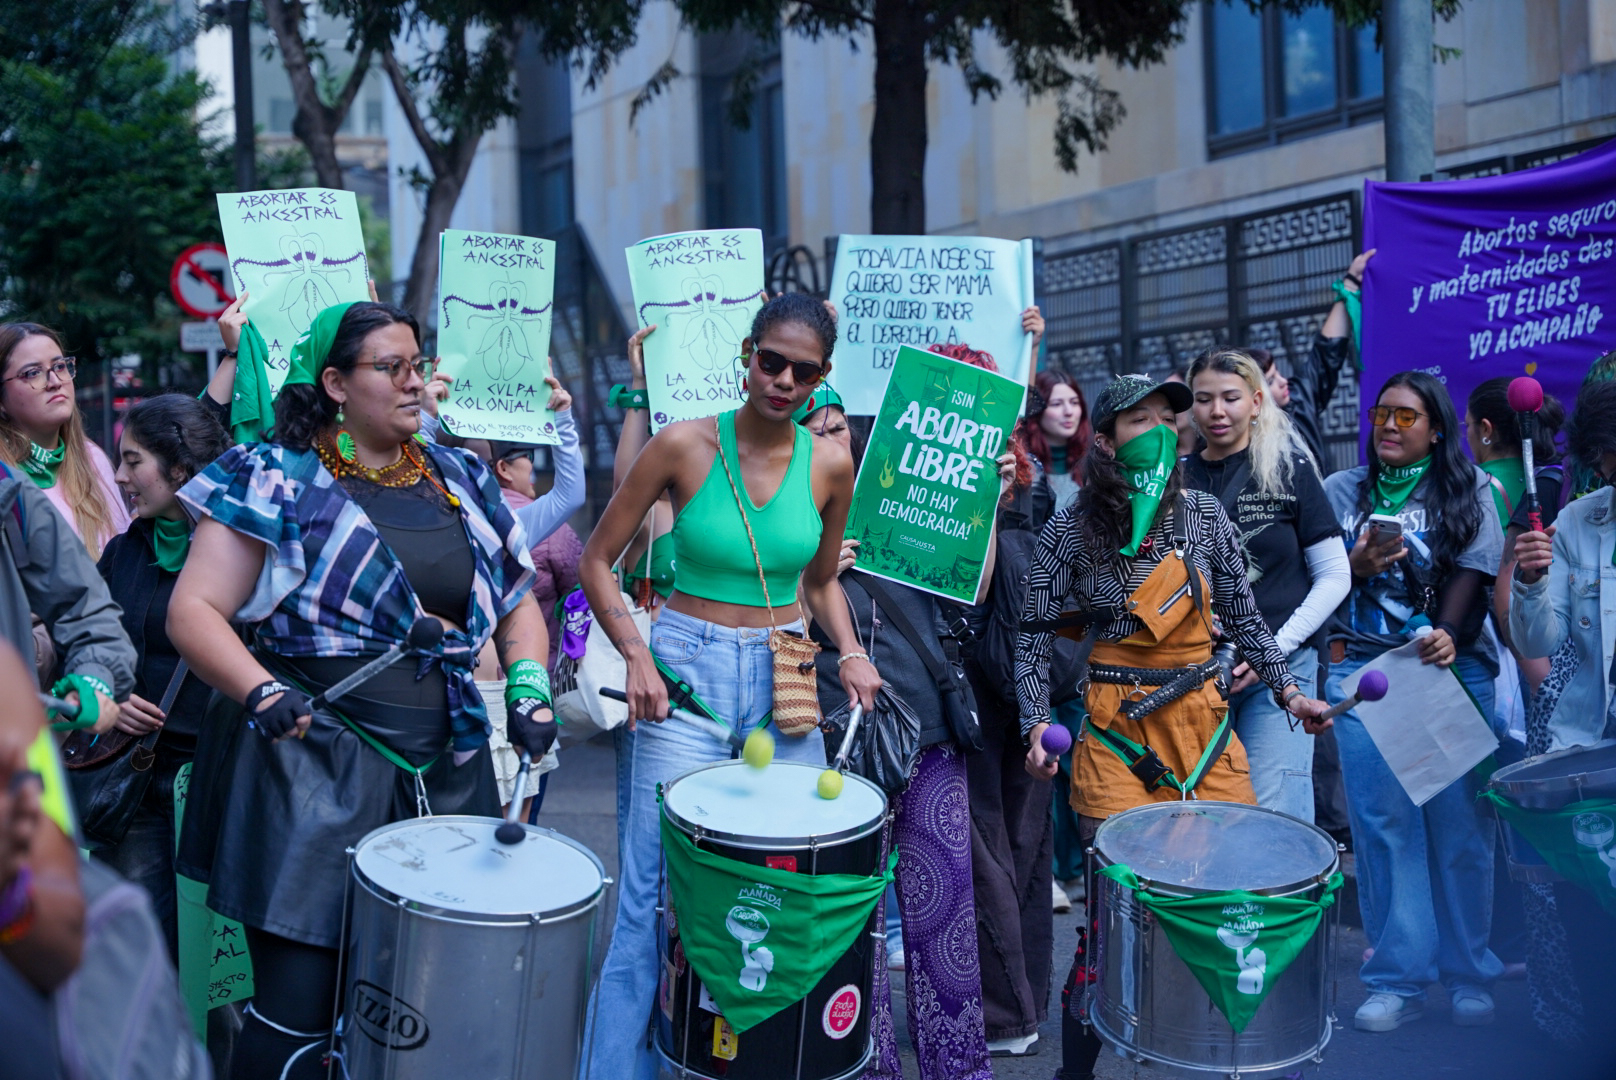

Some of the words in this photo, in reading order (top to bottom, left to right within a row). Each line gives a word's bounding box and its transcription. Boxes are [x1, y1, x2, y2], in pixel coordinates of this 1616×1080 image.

[236, 192, 309, 209] ABORTAR
[318, 191, 337, 205] ES
[241, 206, 343, 224] ANCESTRAL
[462, 234, 525, 252] ABORTAR
[532, 241, 544, 255] ES
[645, 236, 712, 257] ABORTAR
[721, 234, 742, 247] ES
[1458, 216, 1539, 258] Abortos
[463, 250, 545, 270] ANCESTRAL
[648, 249, 747, 270] ANCESTRAL
[849, 247, 927, 269] TODAVIA
[974, 248, 996, 270] SI
[846, 270, 903, 294] QUIERO
[909, 272, 941, 295] SER
[945, 274, 993, 295] MAMA
[1408, 285, 1424, 313] y
[1429, 244, 1570, 302] maternidades
[1515, 276, 1581, 316] ELIGES
[843, 294, 880, 319] PERO
[883, 299, 927, 320] QUIERO
[932, 301, 974, 321] TENER
[847, 322, 865, 344] EL
[871, 323, 939, 345] DERECHO
[947, 325, 959, 344] A
[1469, 329, 1493, 360] YO
[1494, 302, 1604, 354] ACOMPAÑO
[454, 378, 473, 392] LA
[666, 372, 687, 387] LA
[455, 395, 535, 413] COLONIAL
[467, 423, 487, 434] NO
[894, 400, 1003, 460] ABORTO
[906, 483, 928, 505] NO
[929, 490, 959, 514] HAY
[1237, 491, 1270, 503] Nadie
[878, 498, 972, 541] DEMOCRACIA!
[1238, 512, 1275, 523] cariño
[738, 887, 783, 907] MANADA
